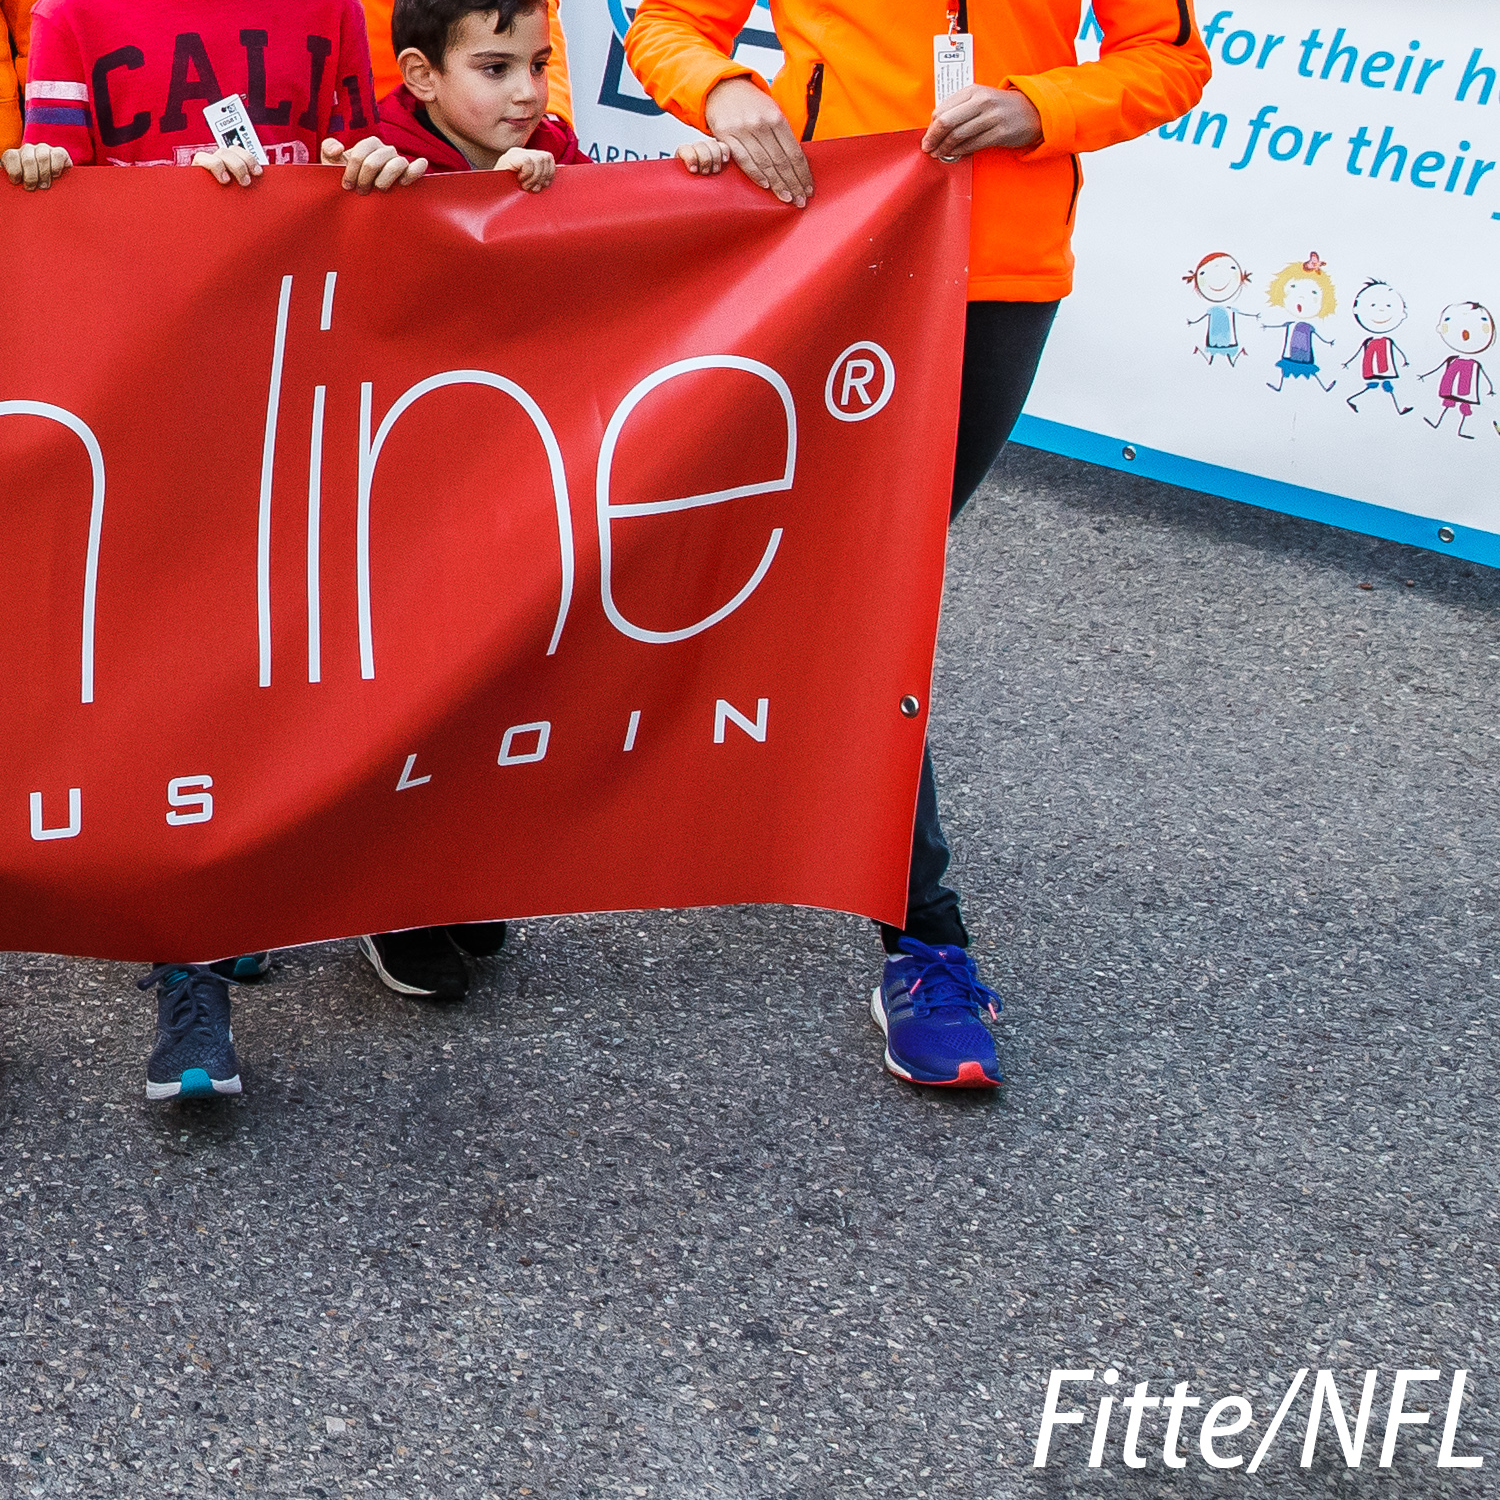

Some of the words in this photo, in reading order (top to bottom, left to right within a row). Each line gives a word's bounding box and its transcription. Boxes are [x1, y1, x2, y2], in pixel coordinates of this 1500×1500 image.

[92, 29, 332, 147] CALI
[1202, 10, 1285, 69] for
[1298, 28, 1444, 95] their
[1455, 47, 1500, 105] h
[1144, 107, 1229, 149] un
[1229, 105, 1332, 170] for
[1346, 126, 1497, 197] their
[396, 697, 770, 792] LOIN
